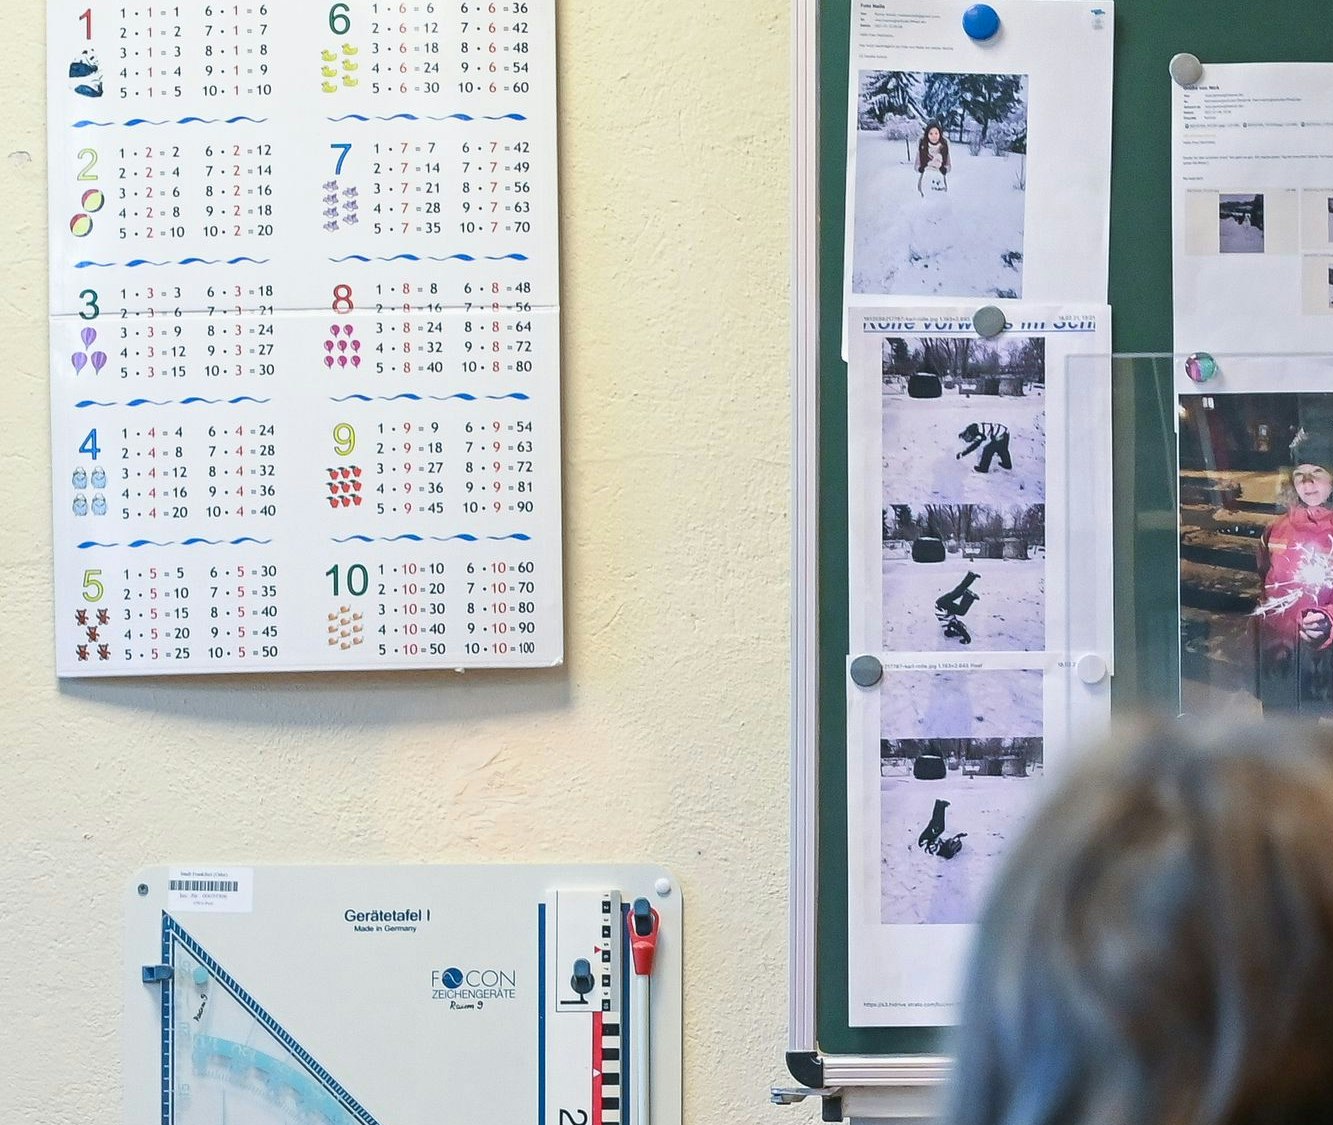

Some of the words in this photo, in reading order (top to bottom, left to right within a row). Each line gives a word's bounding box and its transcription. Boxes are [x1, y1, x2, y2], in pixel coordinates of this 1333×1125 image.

[329, 3, 350, 35] 6
[77, 148, 98, 181] 2
[119, 168, 126, 179] 2
[146, 167, 152, 178] 2
[173, 167, 179, 177] 4
[331, 144, 352, 175] 7
[463, 202, 470, 213] 9
[491, 202, 497, 212] 7
[515, 202, 529, 212] 63
[79, 289, 100, 321] 3
[332, 284, 353, 315] 8
[79, 428, 101, 460] 4
[333, 423, 355, 456] 9
[123, 508, 129, 519] 5
[149, 508, 156, 518] 4
[173, 507, 187, 518] 20
[83, 570, 104, 602] 5
[326, 564, 368, 596] 10
[465, 643, 480, 654] 10
[492, 643, 507, 653] 10
[519, 642, 534, 653] 100
[345, 909, 421, 922] Gerätetafel
[384, 925, 416, 933] Germany
[431, 987, 516, 999] ZEICHENGERÄTE
[477, 1001, 483, 1009] 9
